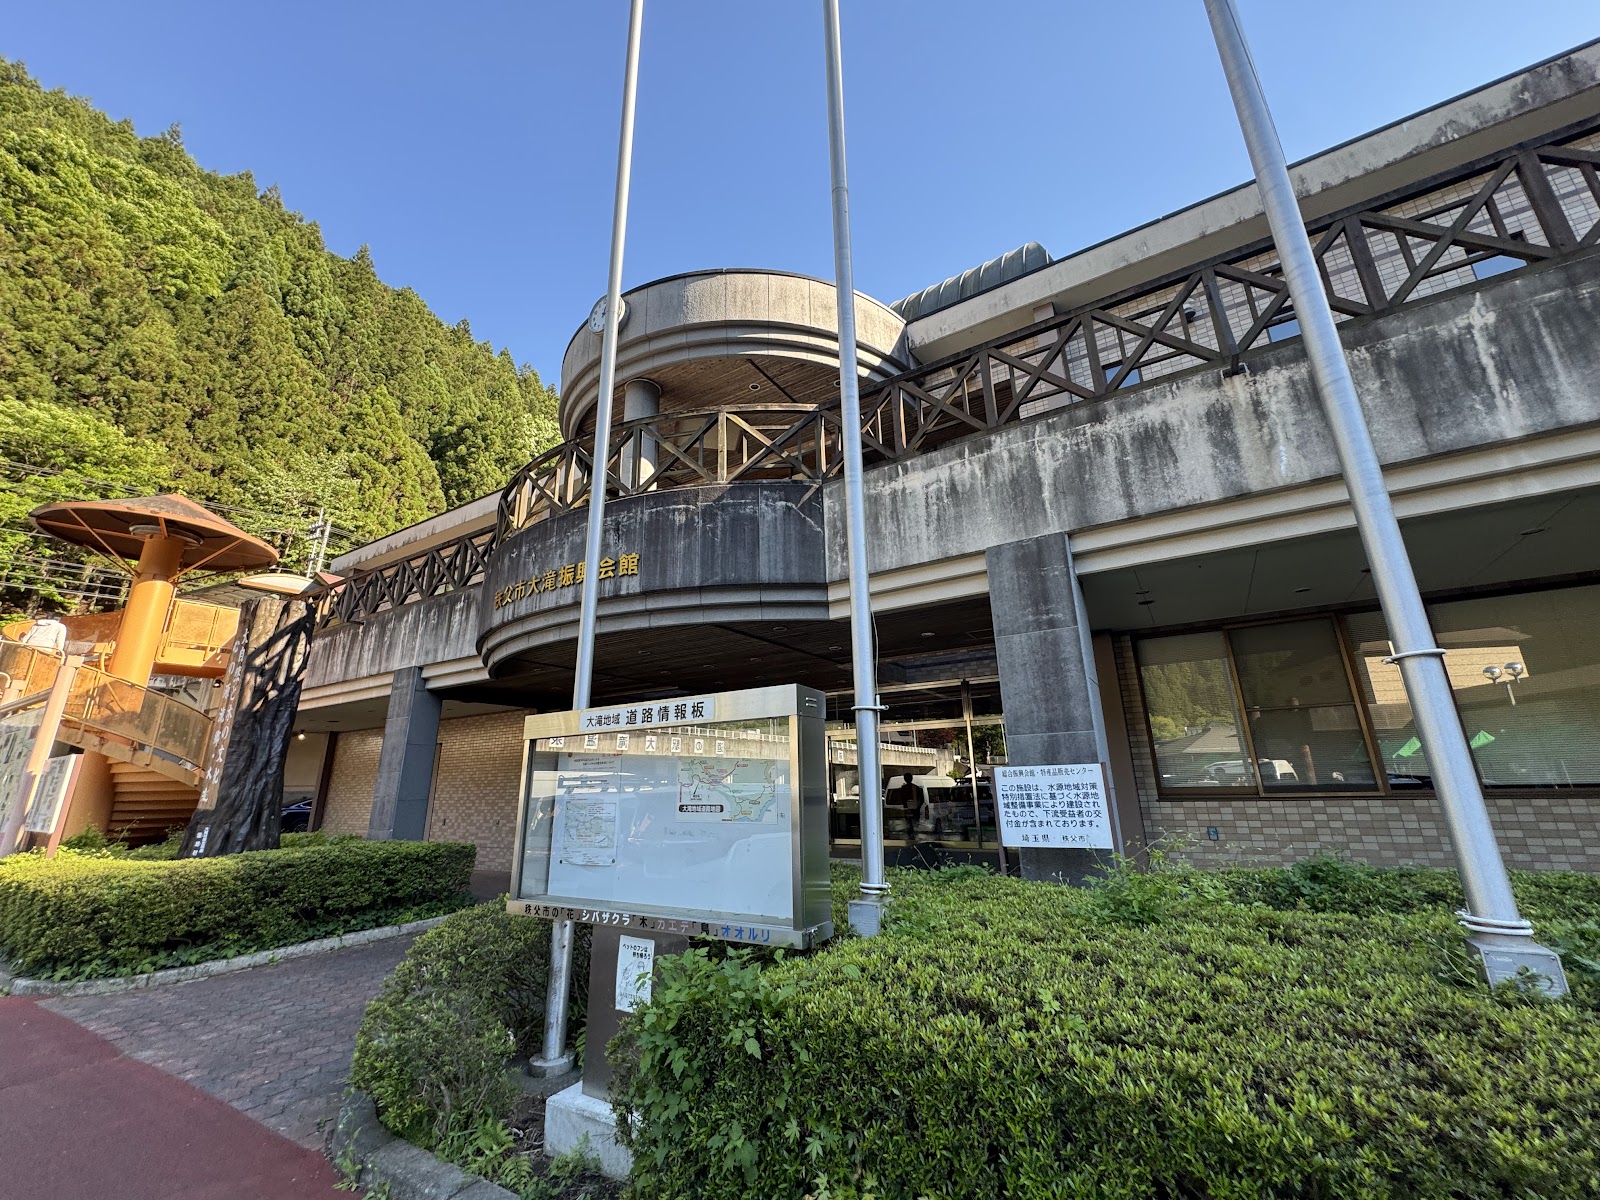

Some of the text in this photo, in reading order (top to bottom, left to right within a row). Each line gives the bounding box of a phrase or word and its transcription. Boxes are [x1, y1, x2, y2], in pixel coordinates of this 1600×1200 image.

[586, 701, 705, 728] 大滝地域 道路情報板
[1001, 782, 1098, 792] この施設は、水源地域対策
[1001, 791, 1100, 801] 特別措置法に基づく水源地
[1003, 801, 1101, 810] 域整備事業により建設され
[1004, 809, 1103, 819] たもので、下流受益者の交
[1005, 819, 1100, 829] 付金が含まれております。
